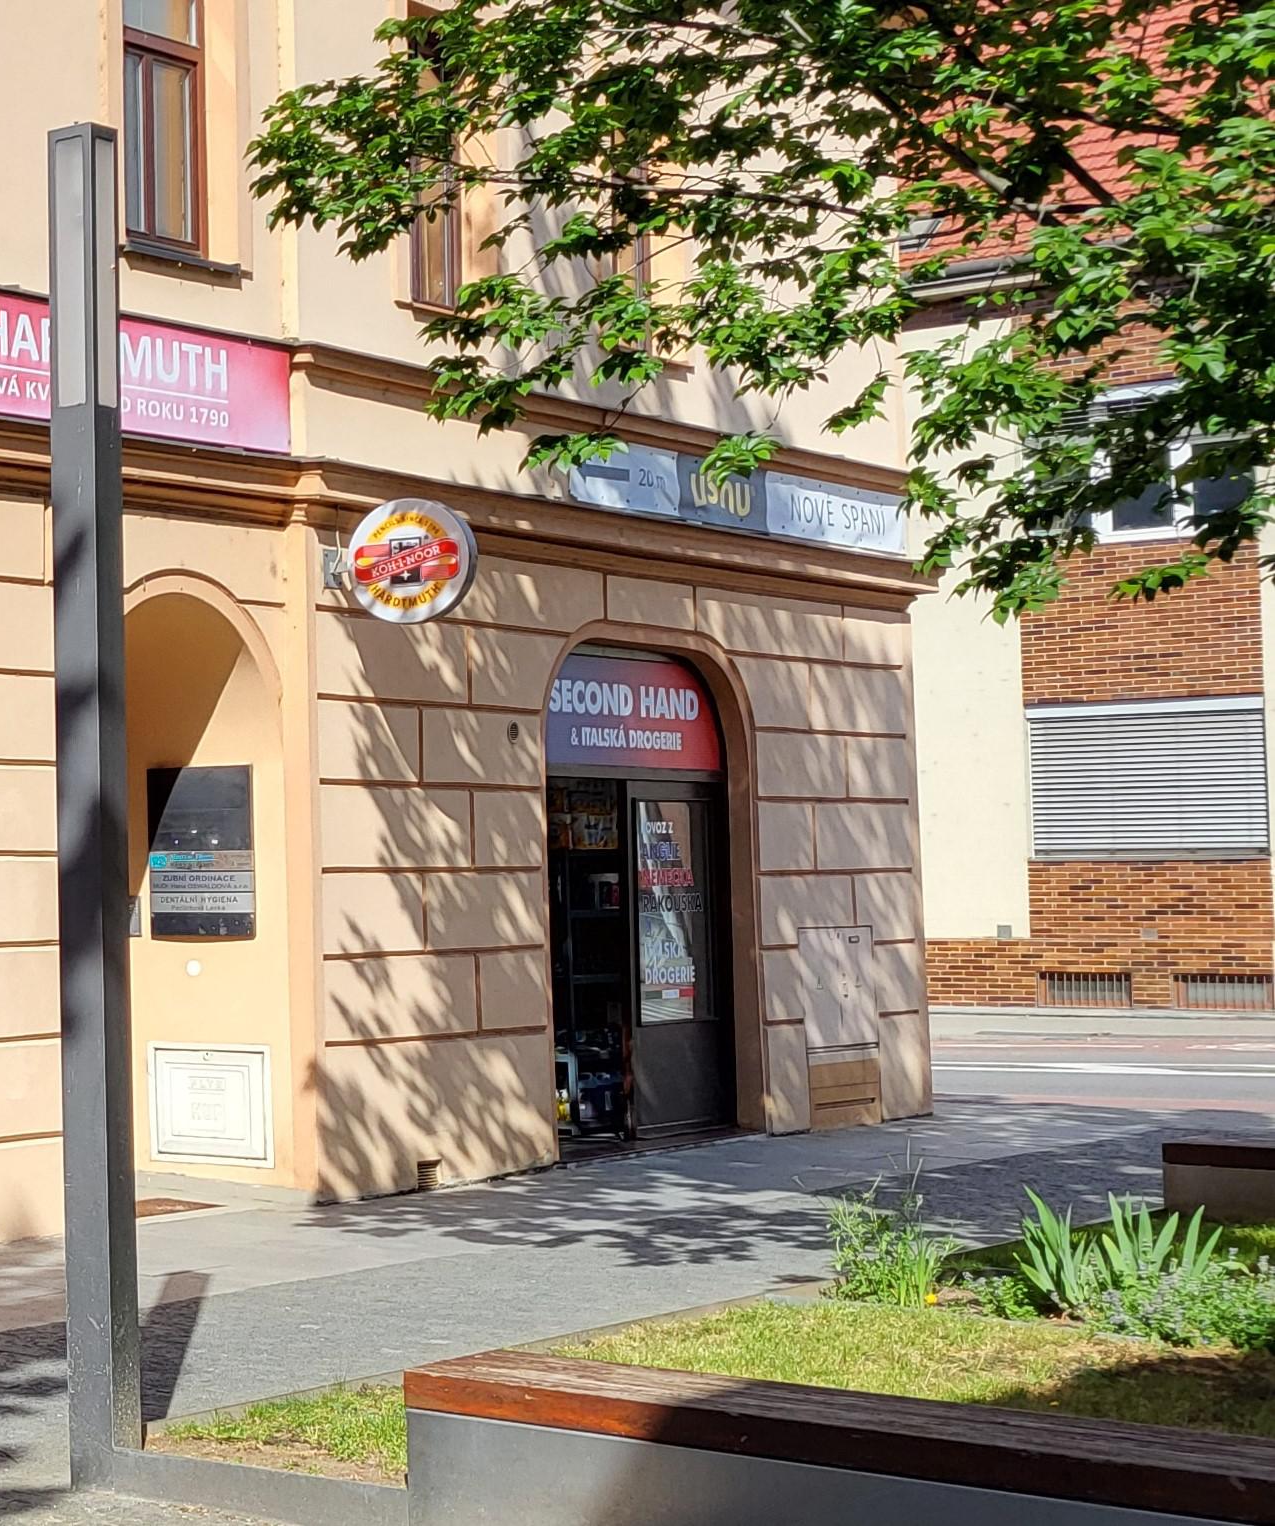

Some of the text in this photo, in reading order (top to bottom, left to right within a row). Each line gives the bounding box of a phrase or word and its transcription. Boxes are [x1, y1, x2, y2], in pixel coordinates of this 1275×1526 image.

[137, 398, 184, 421] ROKU
[189, 406, 229, 428] 1790
[638, 468, 654, 488] 20
[370, 581, 442, 609] HARDTMUTH
[549, 678, 699, 721] SECOND HAND
[571, 724, 682, 751] & ITALSKÁ DROGERIE
[642, 820, 667, 834] OVOZ
[162, 873, 236, 882] ZUBNÍ ORDINACE
[201, 896, 238, 904] HYGIENA
[642, 893, 703, 913] RAKOUSKA
[645, 965, 696, 985] DROGERIE
